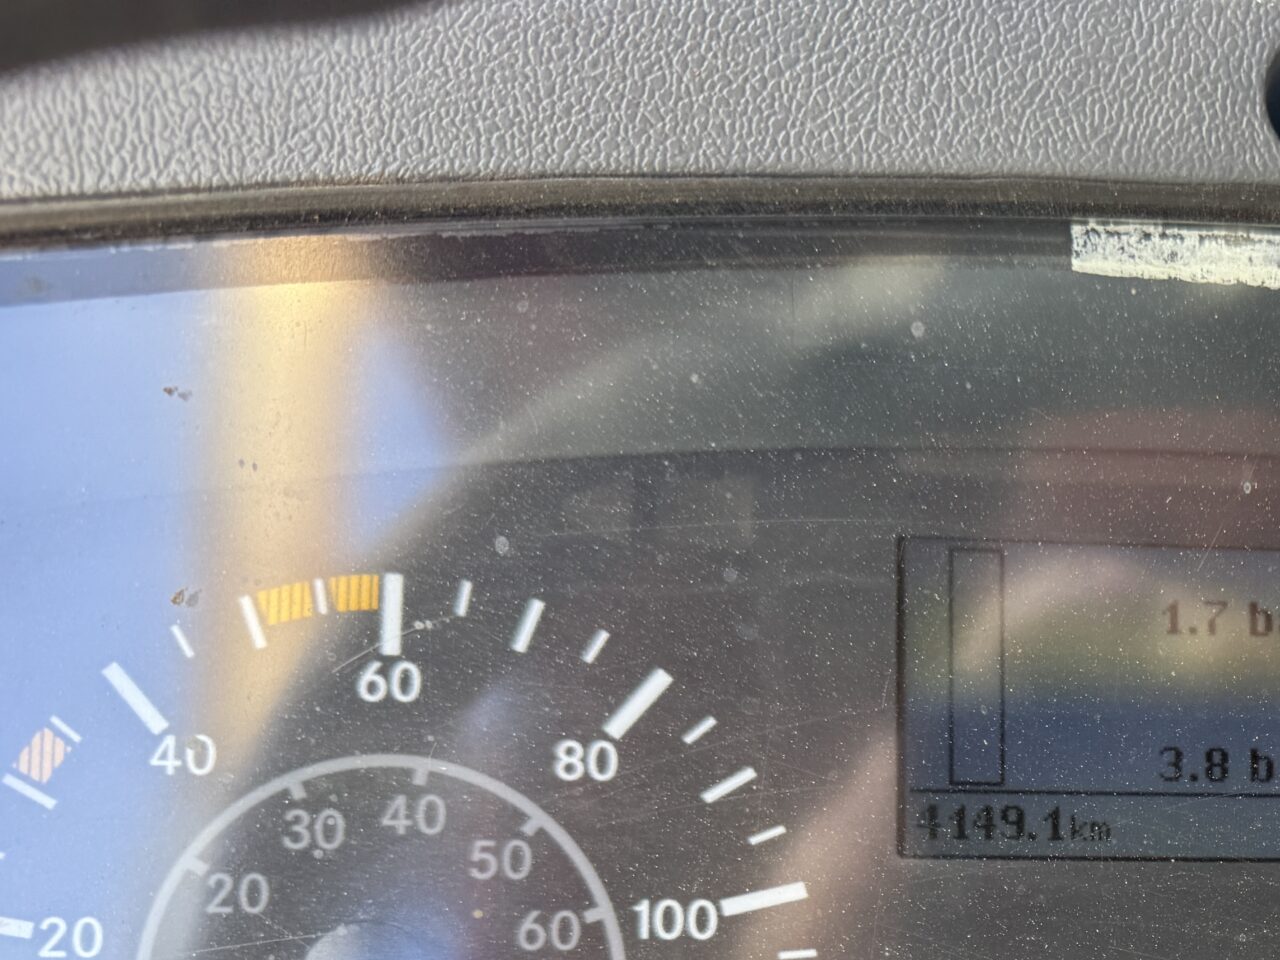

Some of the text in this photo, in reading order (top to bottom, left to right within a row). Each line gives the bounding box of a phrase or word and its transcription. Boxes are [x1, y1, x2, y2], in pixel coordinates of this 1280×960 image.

[1165, 602, 1229, 638] 1.7
[356, 661, 422, 703] 60
[150, 732, 217, 776] 40
[553, 739, 618, 782] 80
[1158, 746, 1229, 784] 3.8
[282, 810, 346, 850] 30
[381, 796, 446, 836] 40
[469, 840, 533, 881] 50
[205, 874, 270, 914] 20
[37, 917, 103, 959] 20
[517, 911, 581, 952] 60
[632, 899, 718, 941] 100
